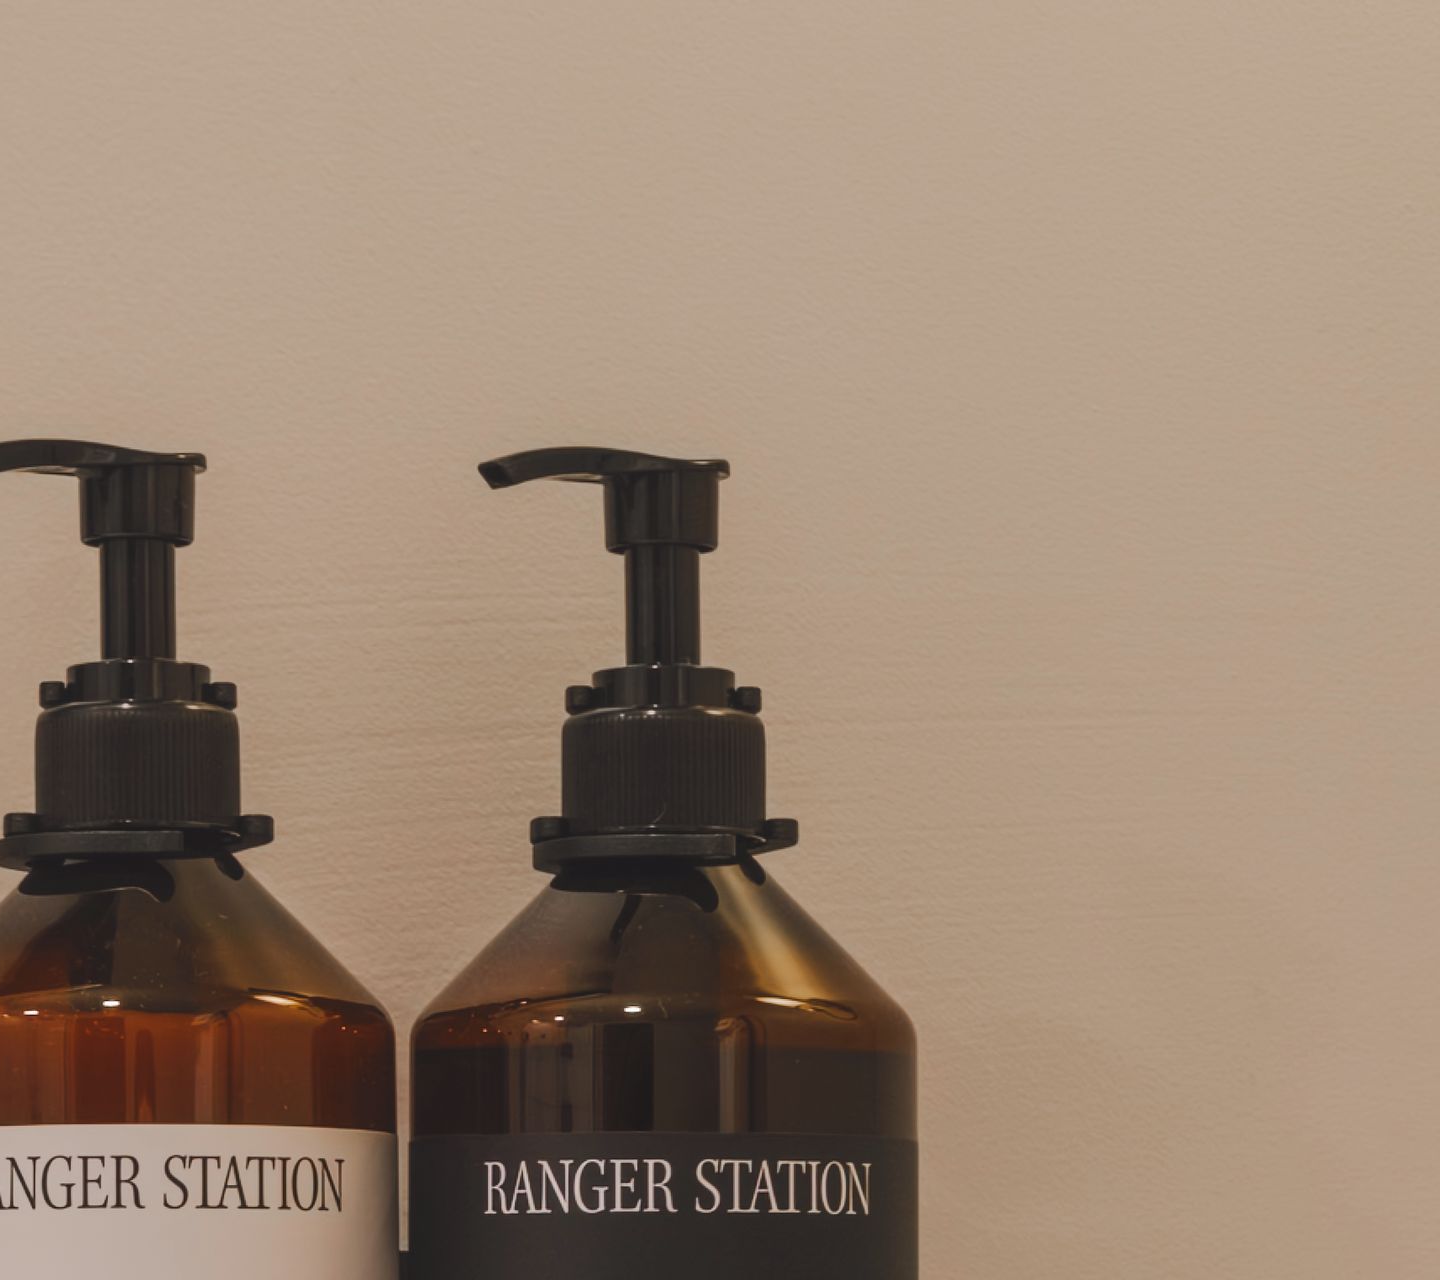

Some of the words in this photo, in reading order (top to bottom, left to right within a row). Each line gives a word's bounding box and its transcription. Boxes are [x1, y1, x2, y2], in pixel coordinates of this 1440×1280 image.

[162, 1155, 345, 1213] STATION
[484, 1159, 678, 1215] RANGER
[695, 1159, 872, 1215] STATION
